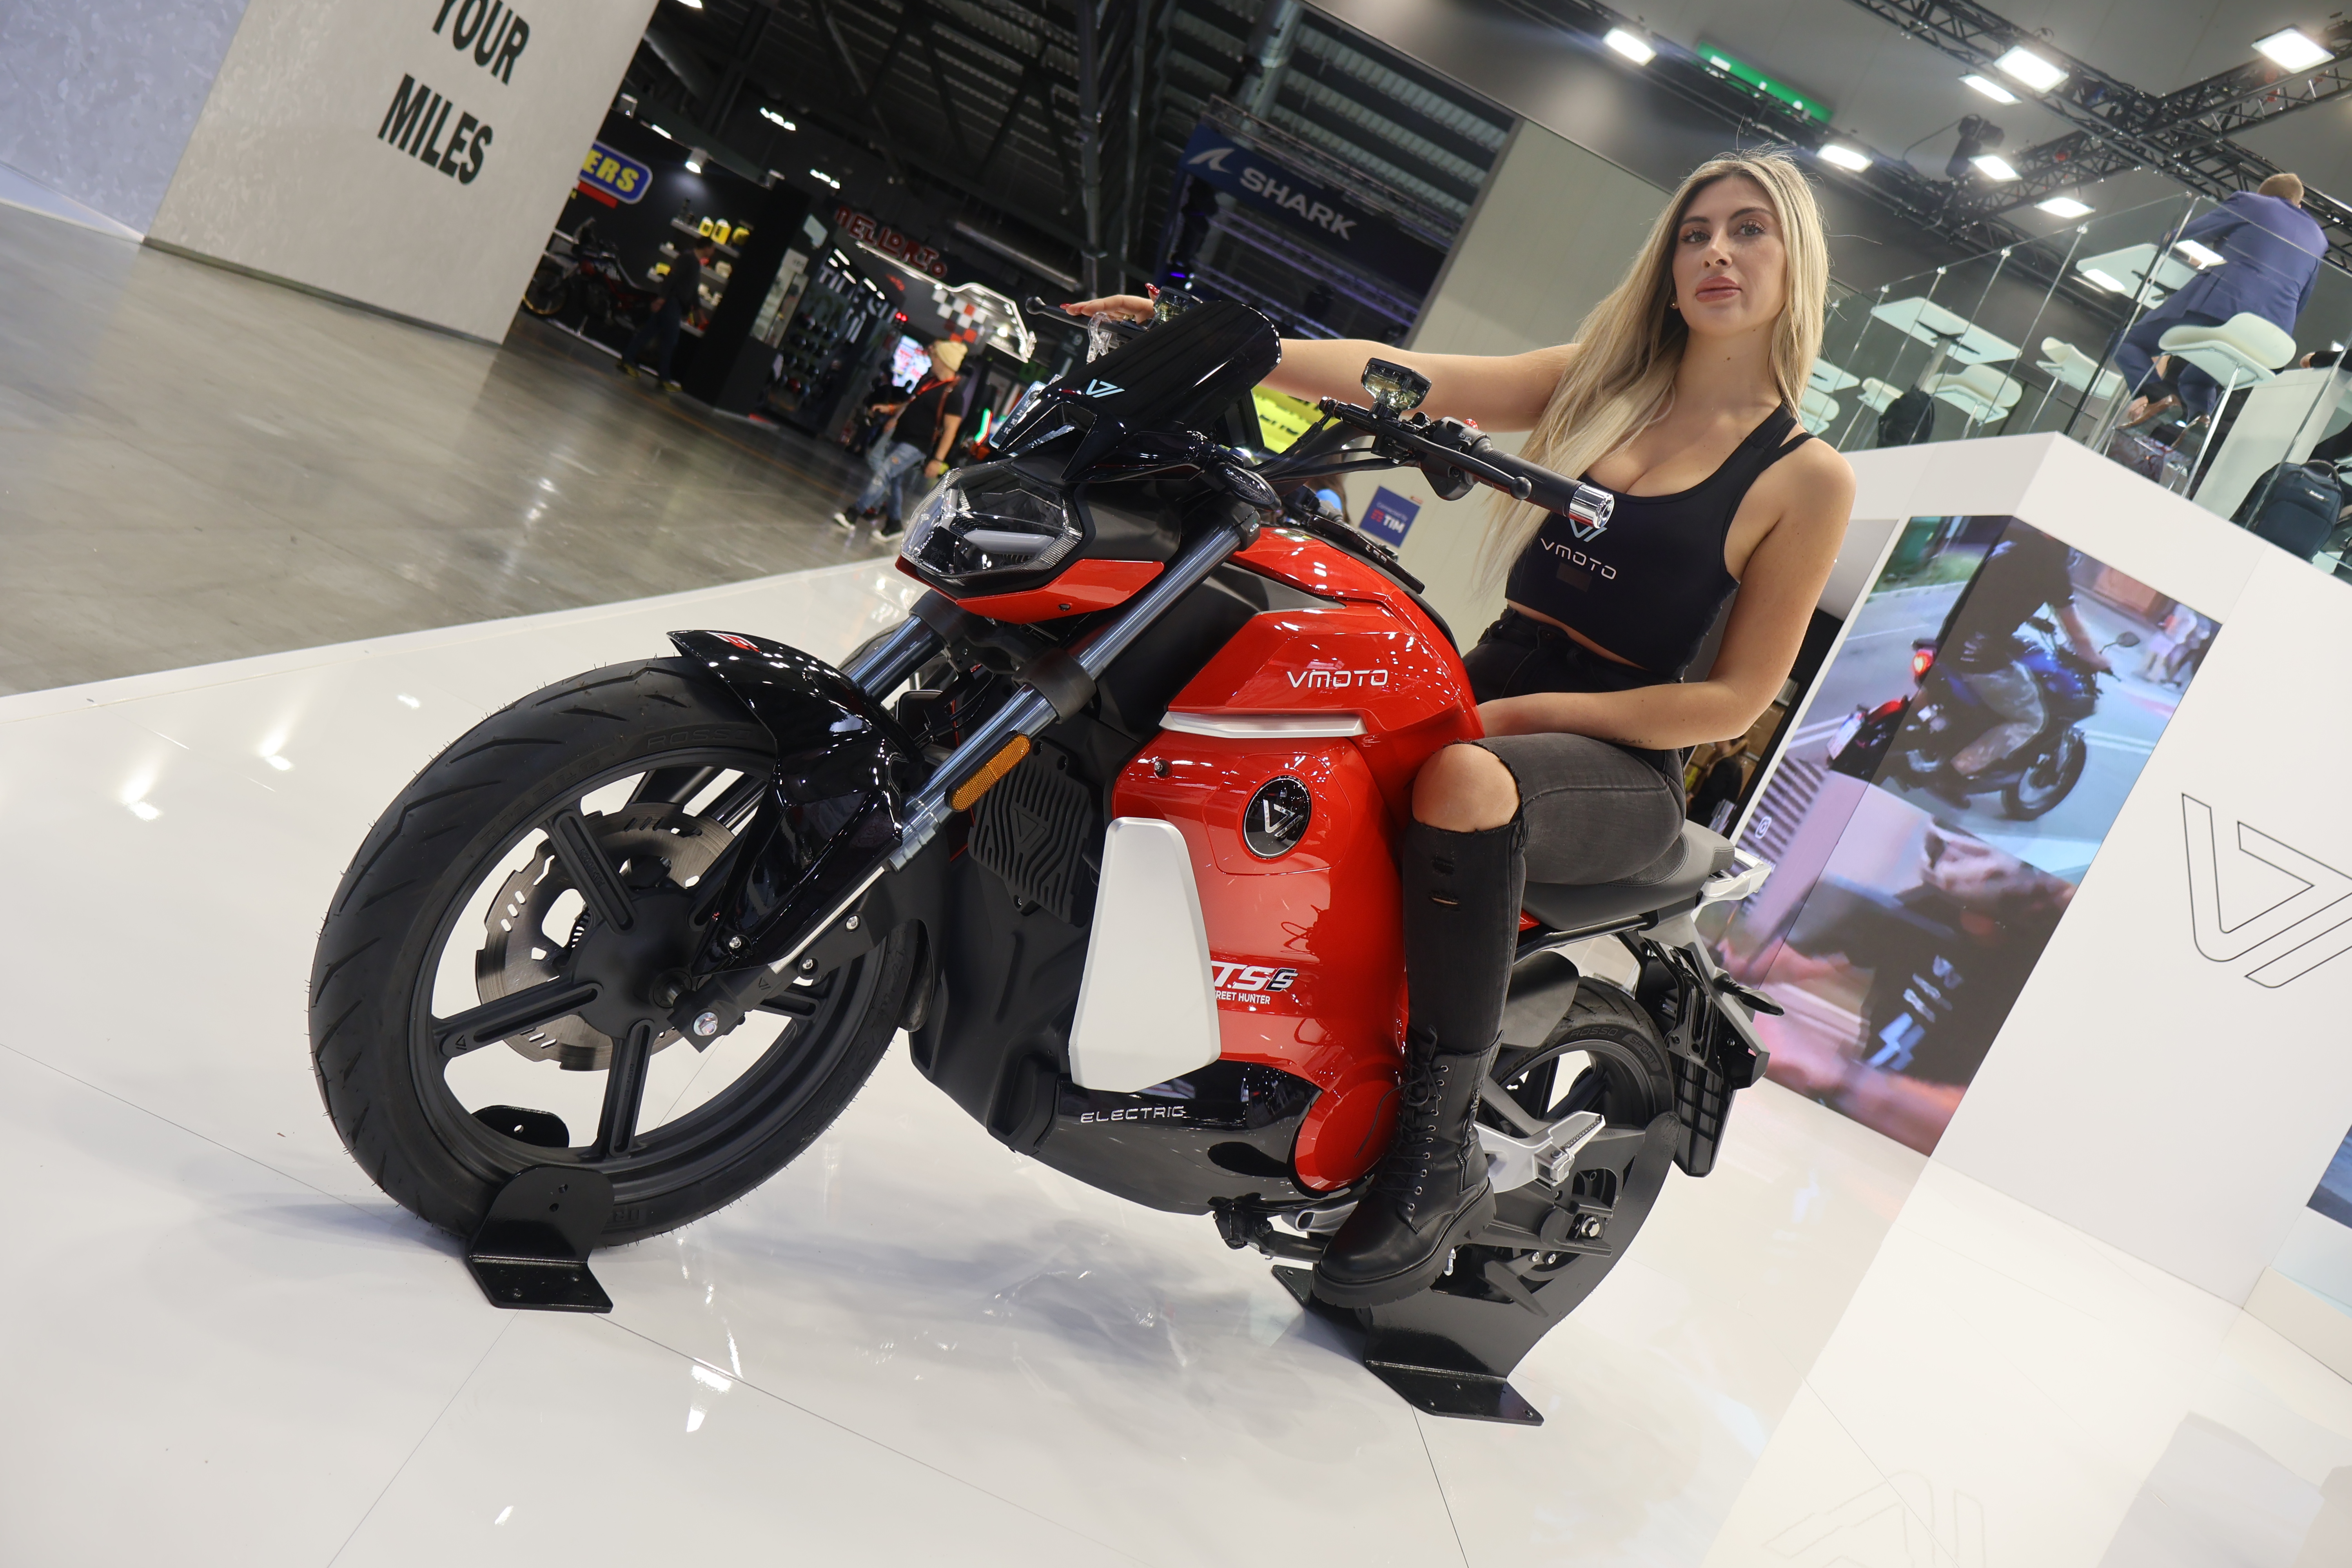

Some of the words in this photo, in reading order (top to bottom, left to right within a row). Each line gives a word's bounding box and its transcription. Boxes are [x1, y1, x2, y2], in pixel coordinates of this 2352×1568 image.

[432, 0, 530, 85] YOUR
[378, 73, 493, 185] MILES
[1239, 167, 1359, 241] SHARK
[1383, 515, 1405, 534] TIM
[1540, 538, 1617, 580] VMOTO
[1287, 669, 1388, 689] VMOTO
[647, 728, 753, 750] ROSSO
[1215, 990, 1237, 1001] REET
[1238, 993, 1271, 1005] HUNTER
[1569, 1027, 1619, 1038] ROSSO
[1629, 1036, 1657, 1065] SPORT
[1080, 1105, 1187, 1123] ELECTRIC
